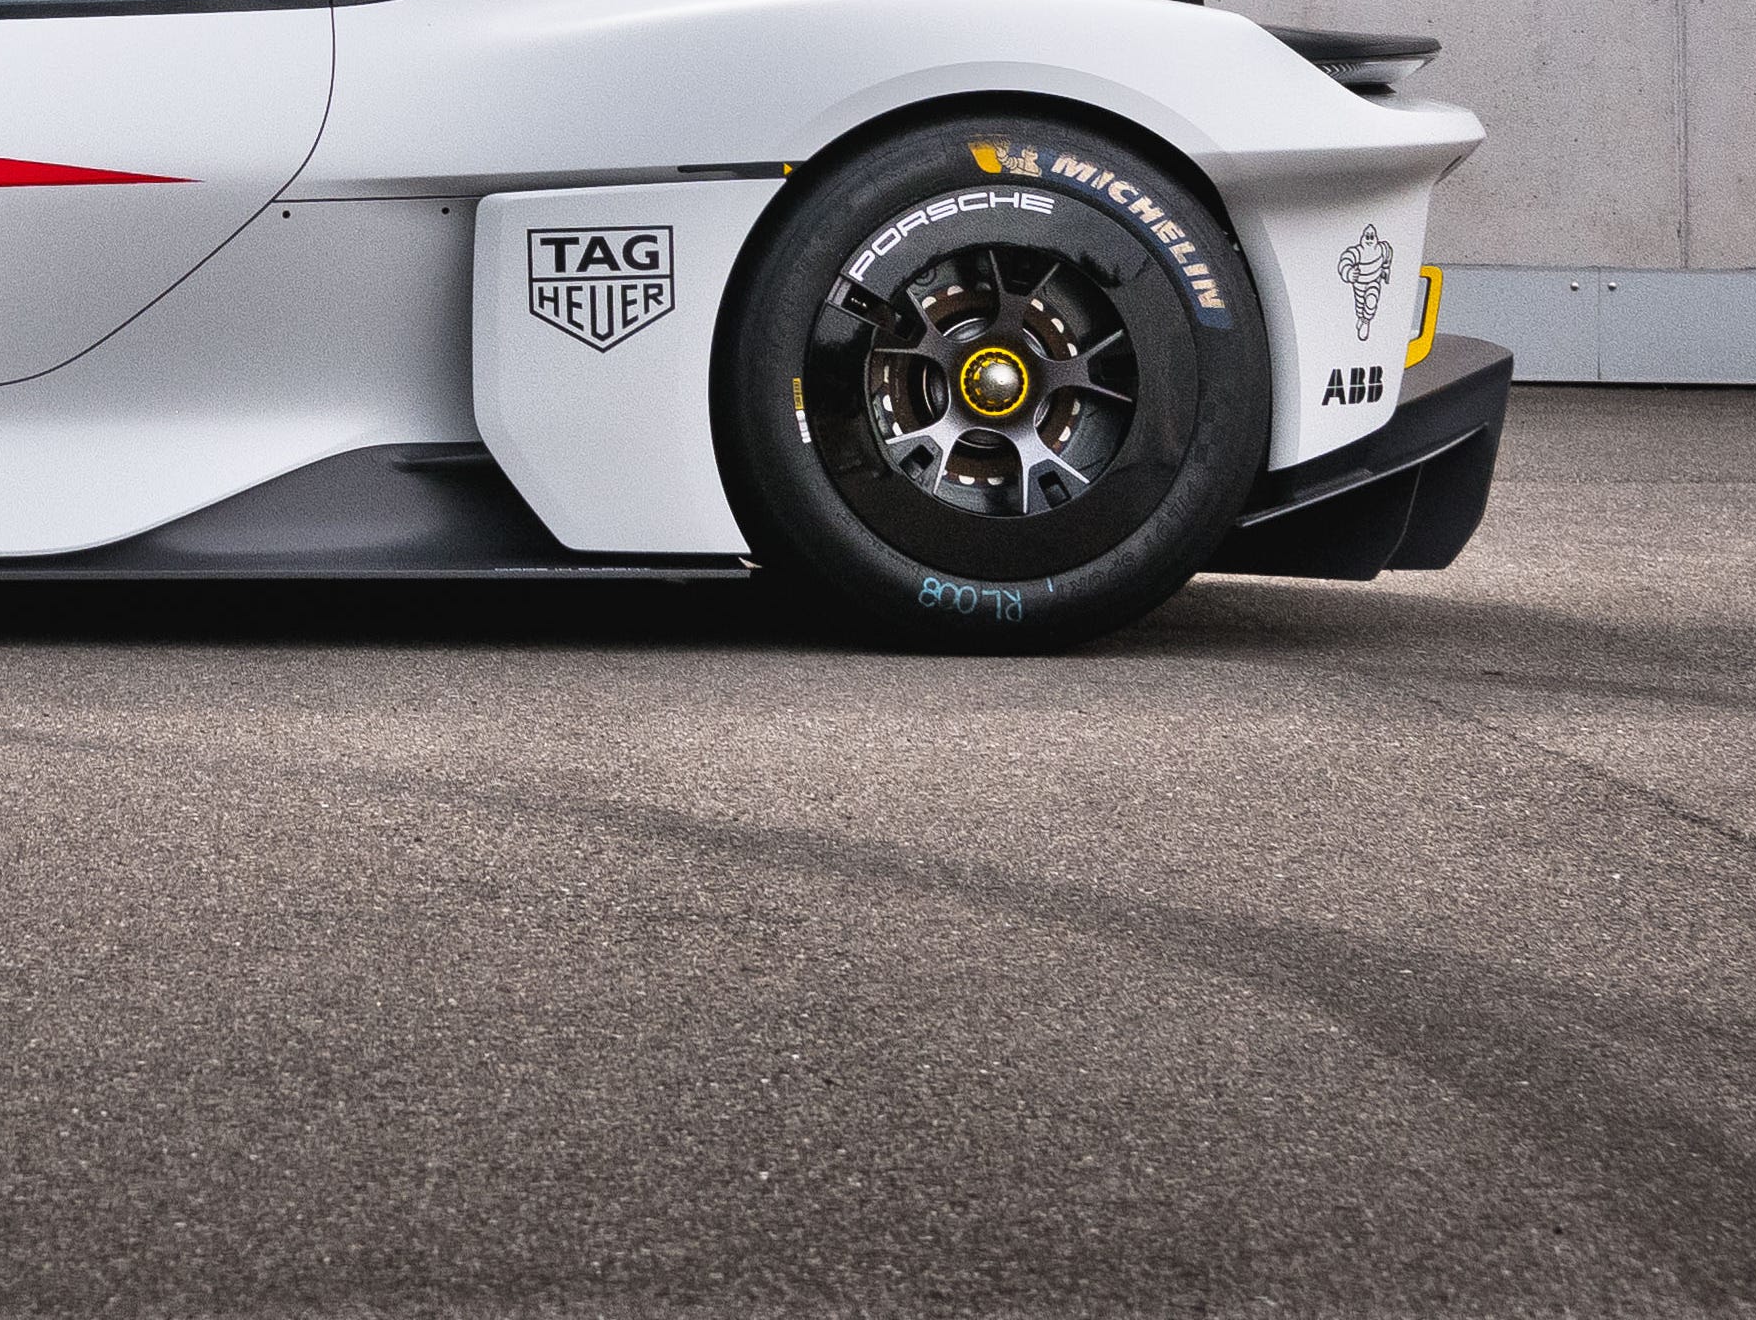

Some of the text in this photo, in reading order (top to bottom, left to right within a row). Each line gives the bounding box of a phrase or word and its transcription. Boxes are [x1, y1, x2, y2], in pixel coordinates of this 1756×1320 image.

[538, 233, 661, 274] TAG
[847, 191, 1056, 283] PORSCHE
[1050, 153, 1227, 310] MICHELIN
[537, 282, 665, 342] HEUER
[1320, 365, 1385, 407] ABB
